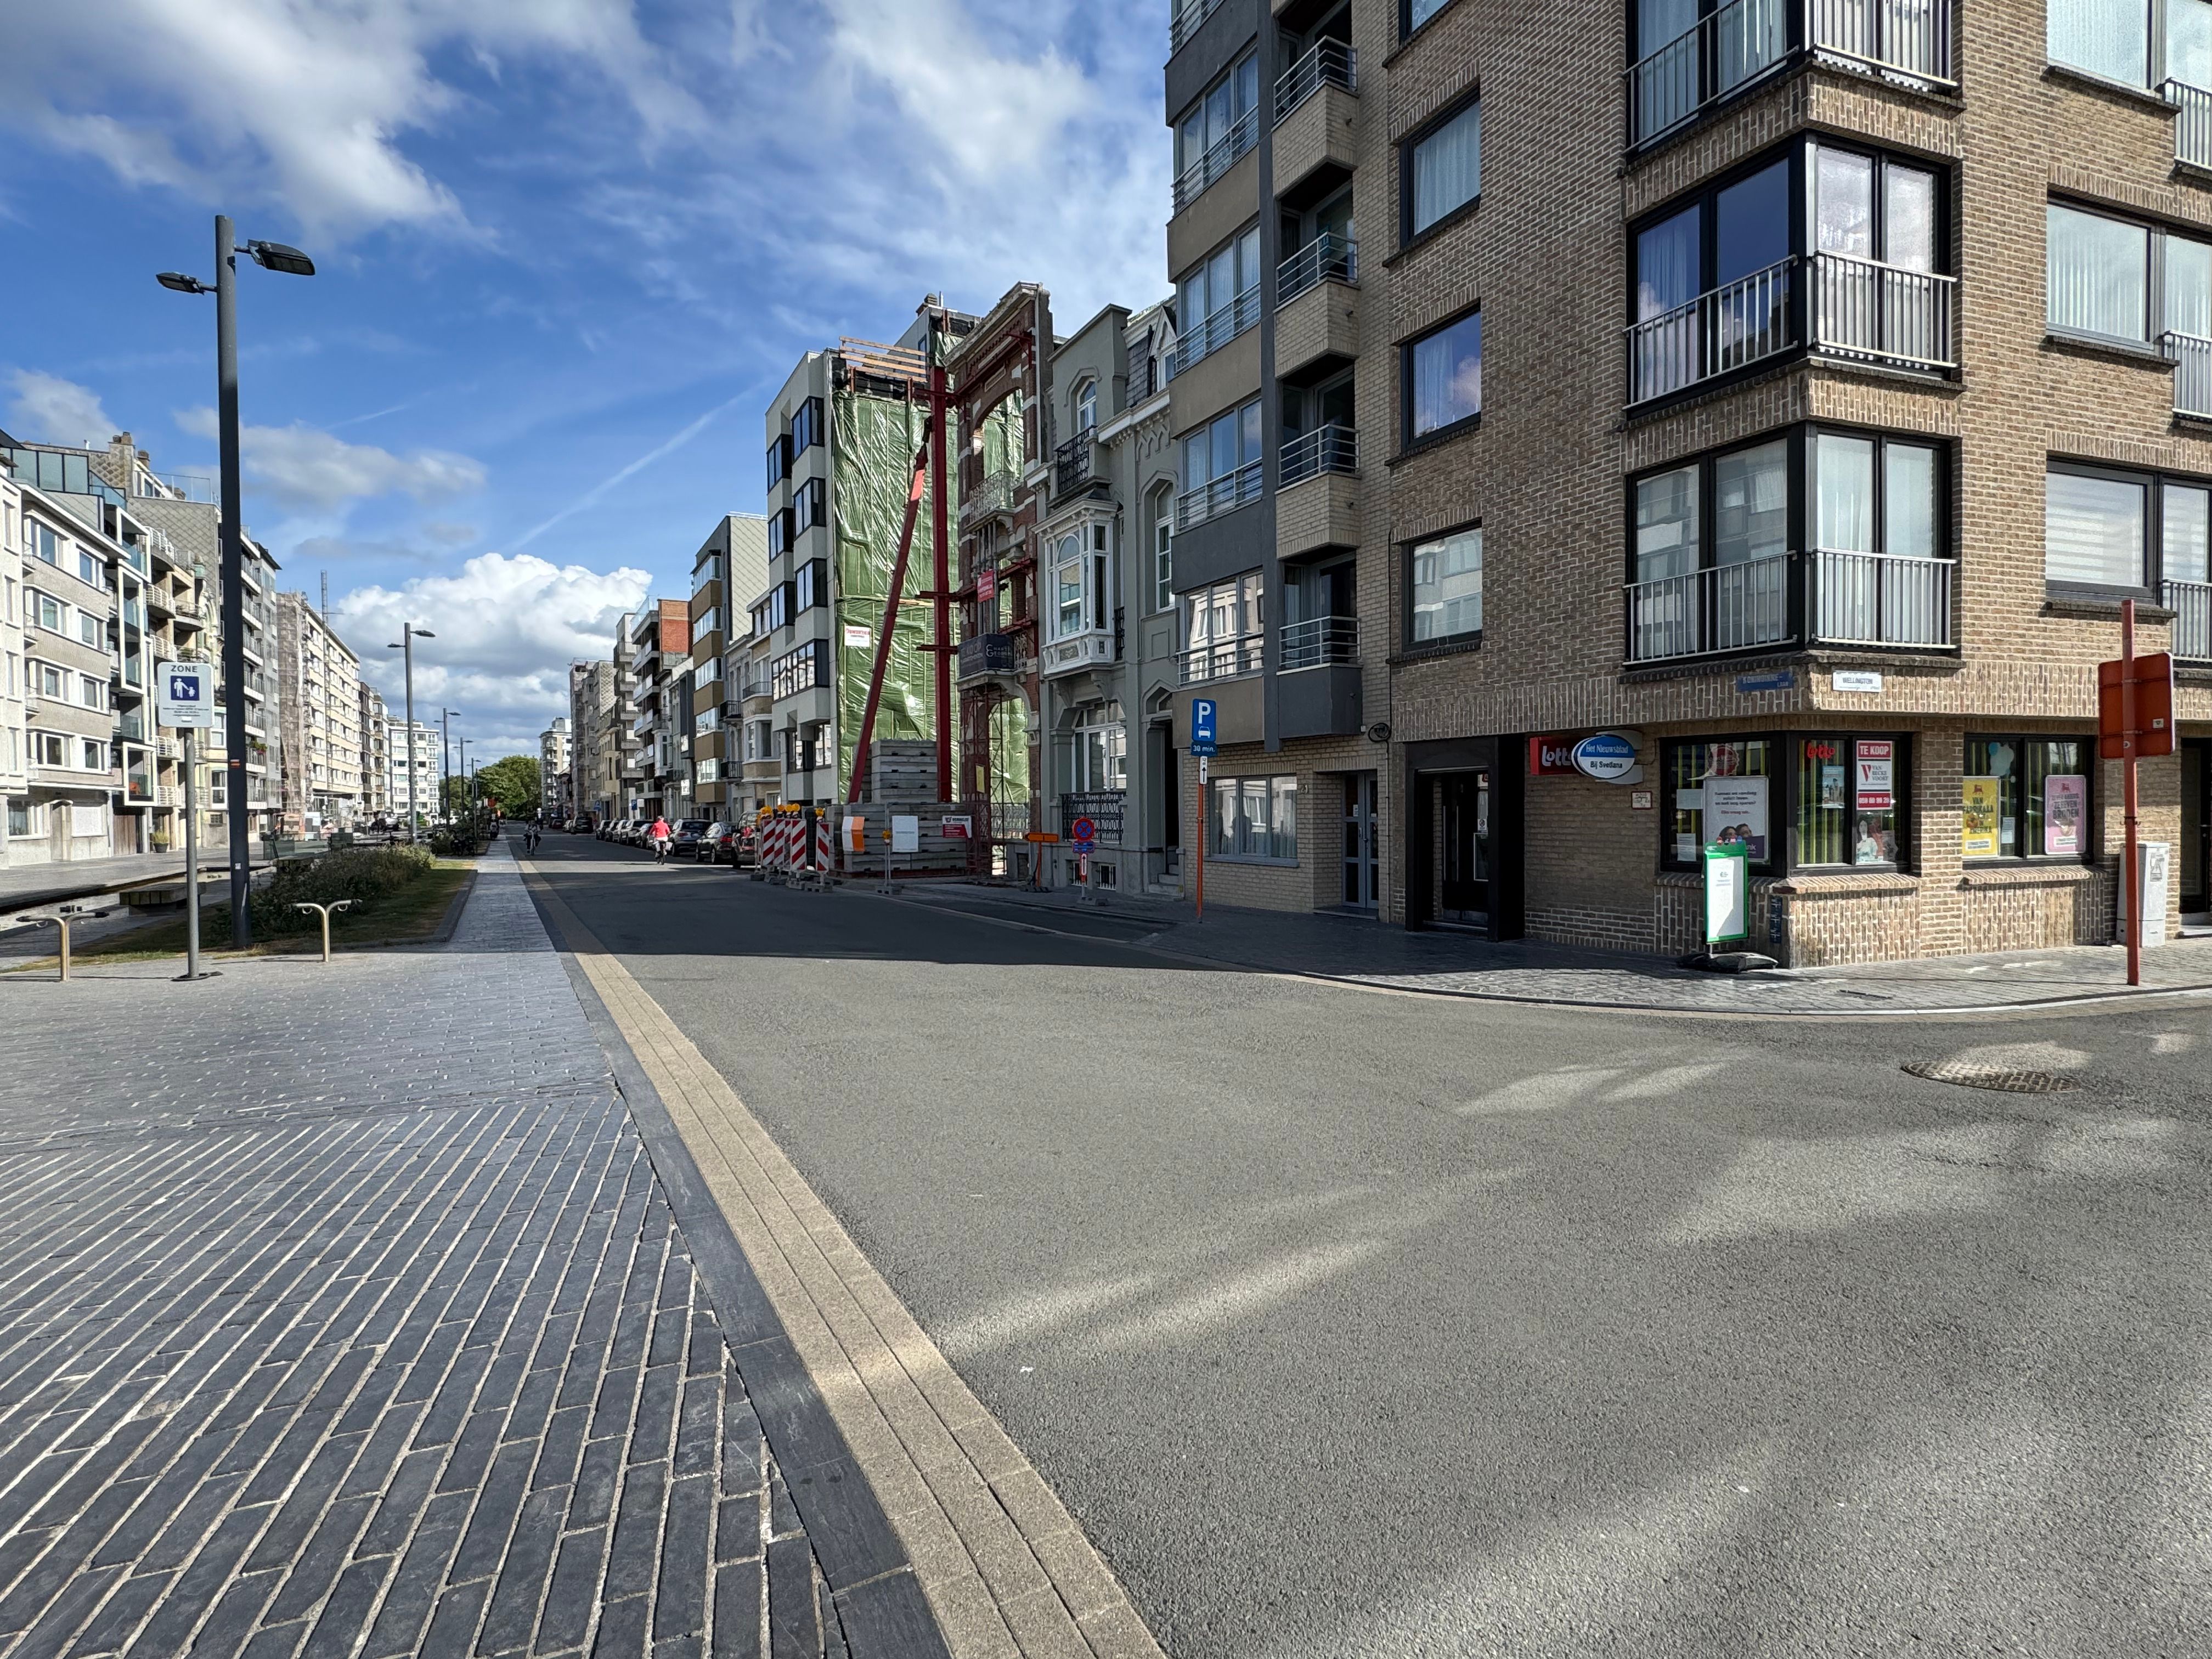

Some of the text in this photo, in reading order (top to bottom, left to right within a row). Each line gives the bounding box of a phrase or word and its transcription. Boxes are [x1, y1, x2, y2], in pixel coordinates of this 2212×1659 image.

[1198, 702, 1211, 724] P
[1586, 744, 1628, 754] Het Nieuwsblad
[1860, 746, 1889, 755] TE KOOP
[1542, 746, 1572, 766] Lott
[1599, 760, 1623, 769] Svetlana
